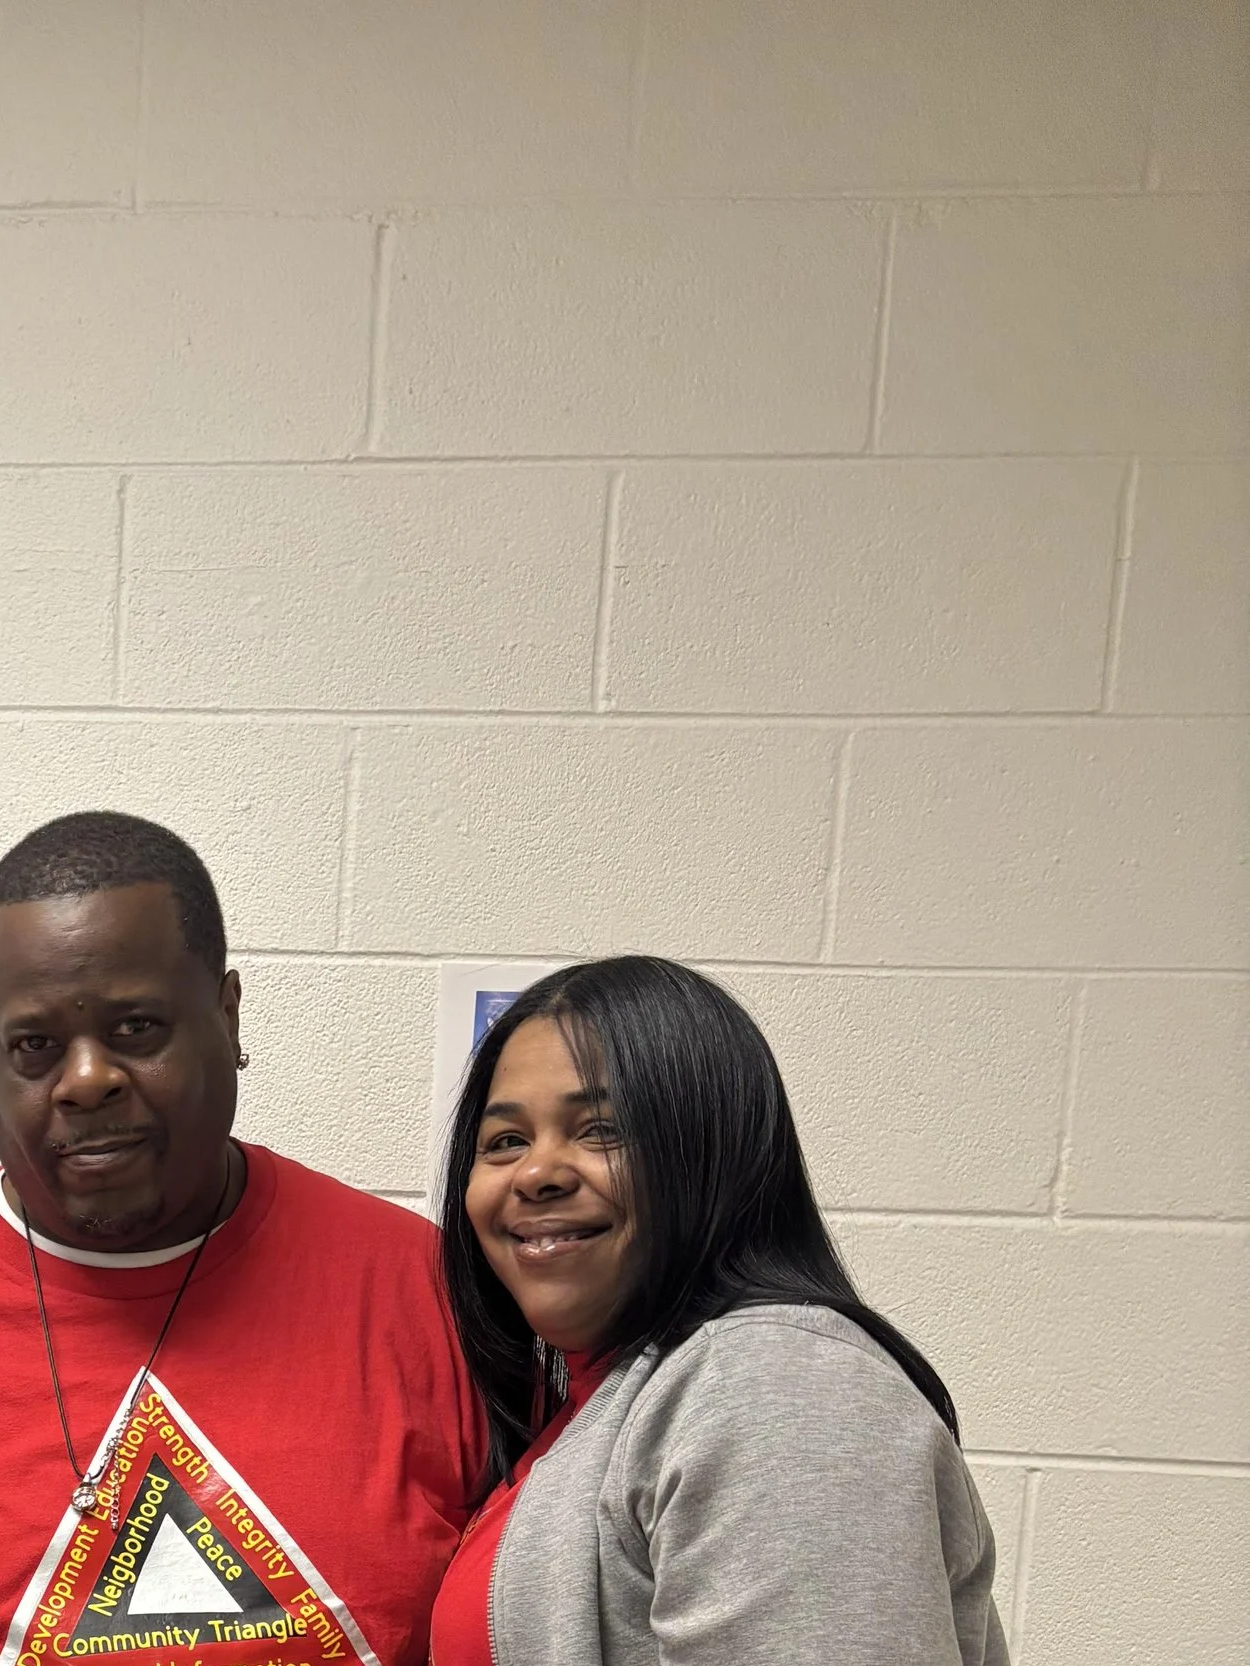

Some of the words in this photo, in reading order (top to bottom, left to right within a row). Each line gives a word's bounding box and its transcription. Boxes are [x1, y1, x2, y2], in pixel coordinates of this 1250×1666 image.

[89, 1473, 170, 1617] Neigborhood
[186, 1516, 242, 1581] Peace
[138, 1393, 211, 1485] Strength
[215, 1486, 295, 1581] Integrity
[290, 1587, 347, 1660] Family
[53, 1625, 199, 1658] Community
[208, 1613, 307, 1645] Triangle
